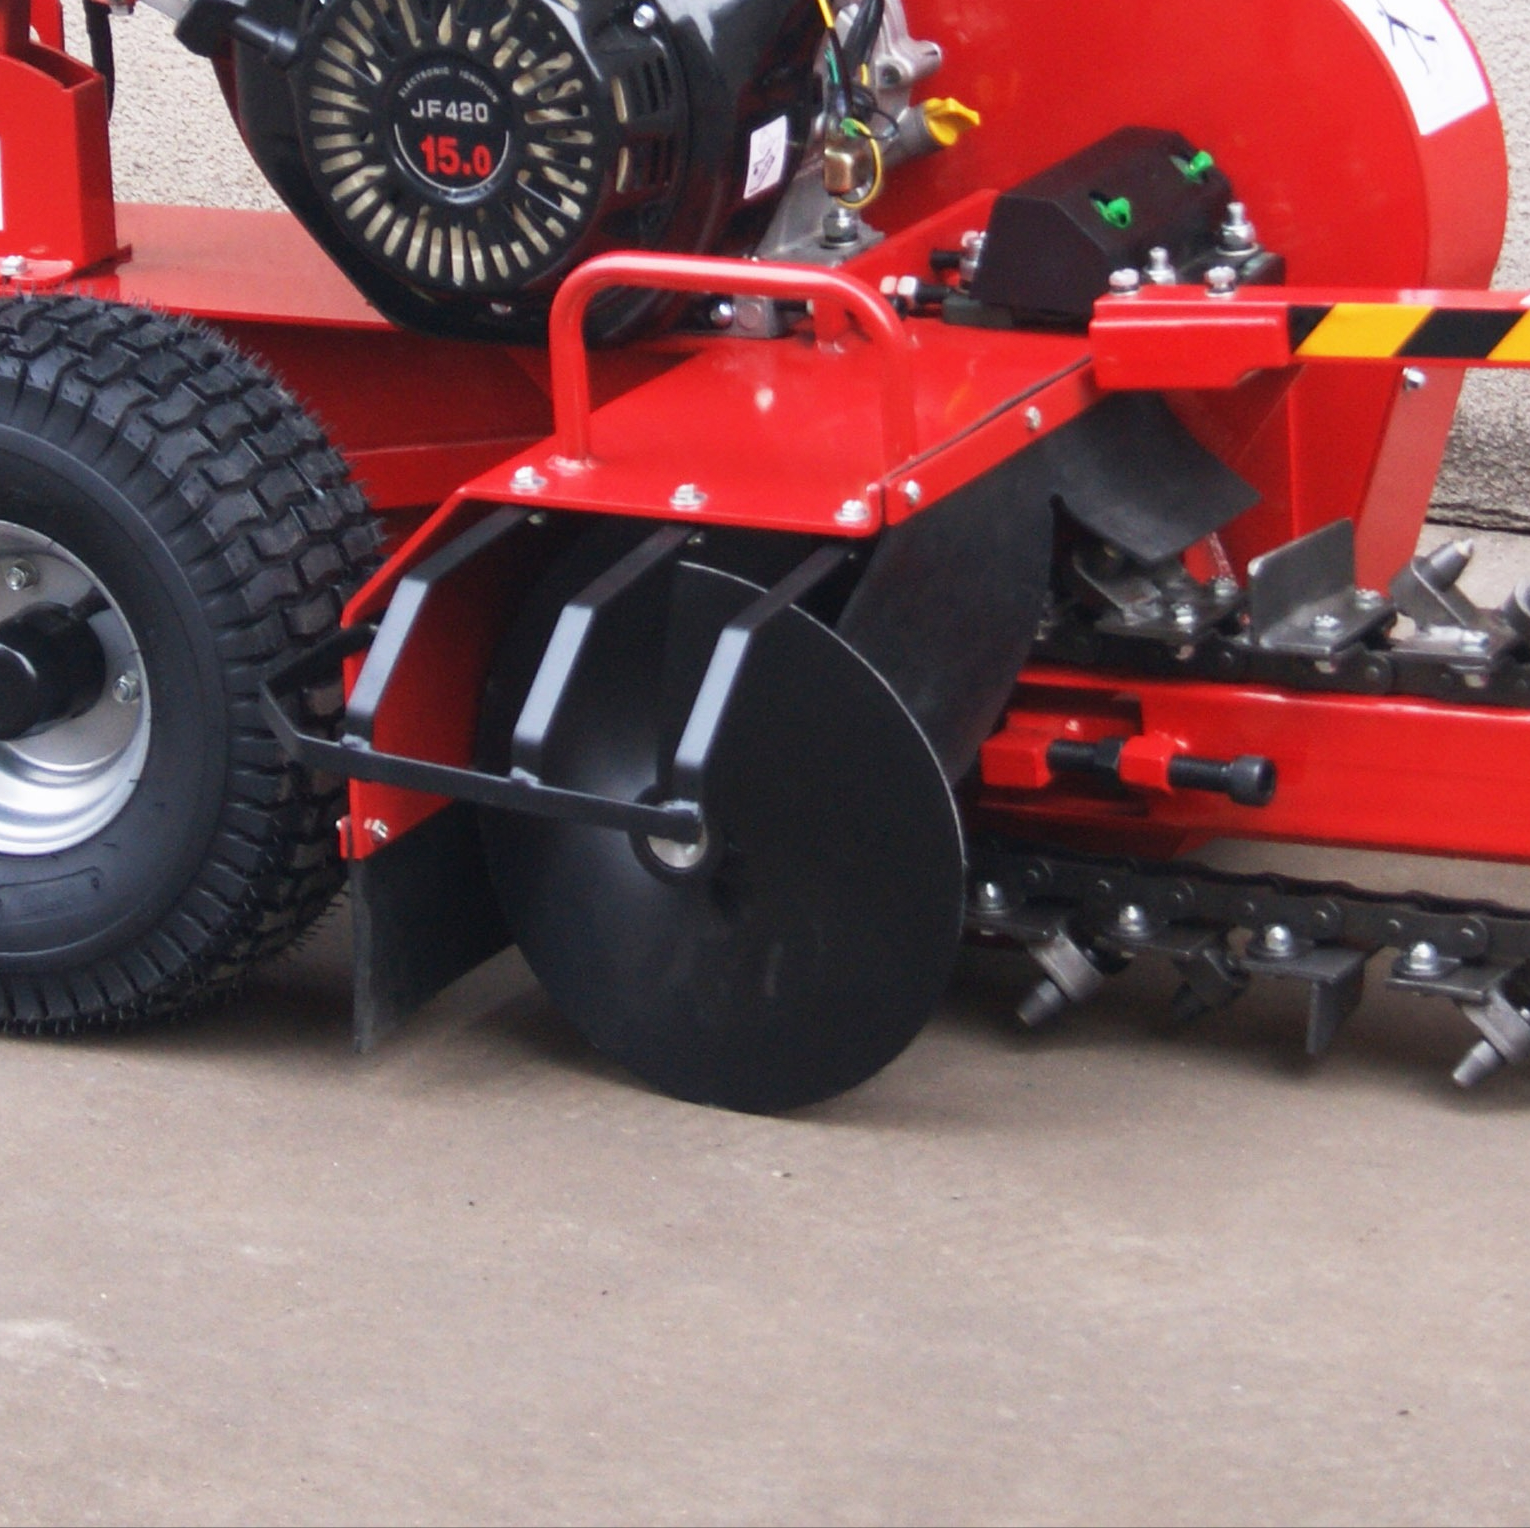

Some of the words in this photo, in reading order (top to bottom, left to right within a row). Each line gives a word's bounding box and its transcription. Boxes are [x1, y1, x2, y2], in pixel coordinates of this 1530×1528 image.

[398, 67, 449, 98] ELECTRONIC
[459, 70, 499, 103] IGNITION
[410, 99, 488, 123] JF420
[420, 134, 491, 177] 15.0
